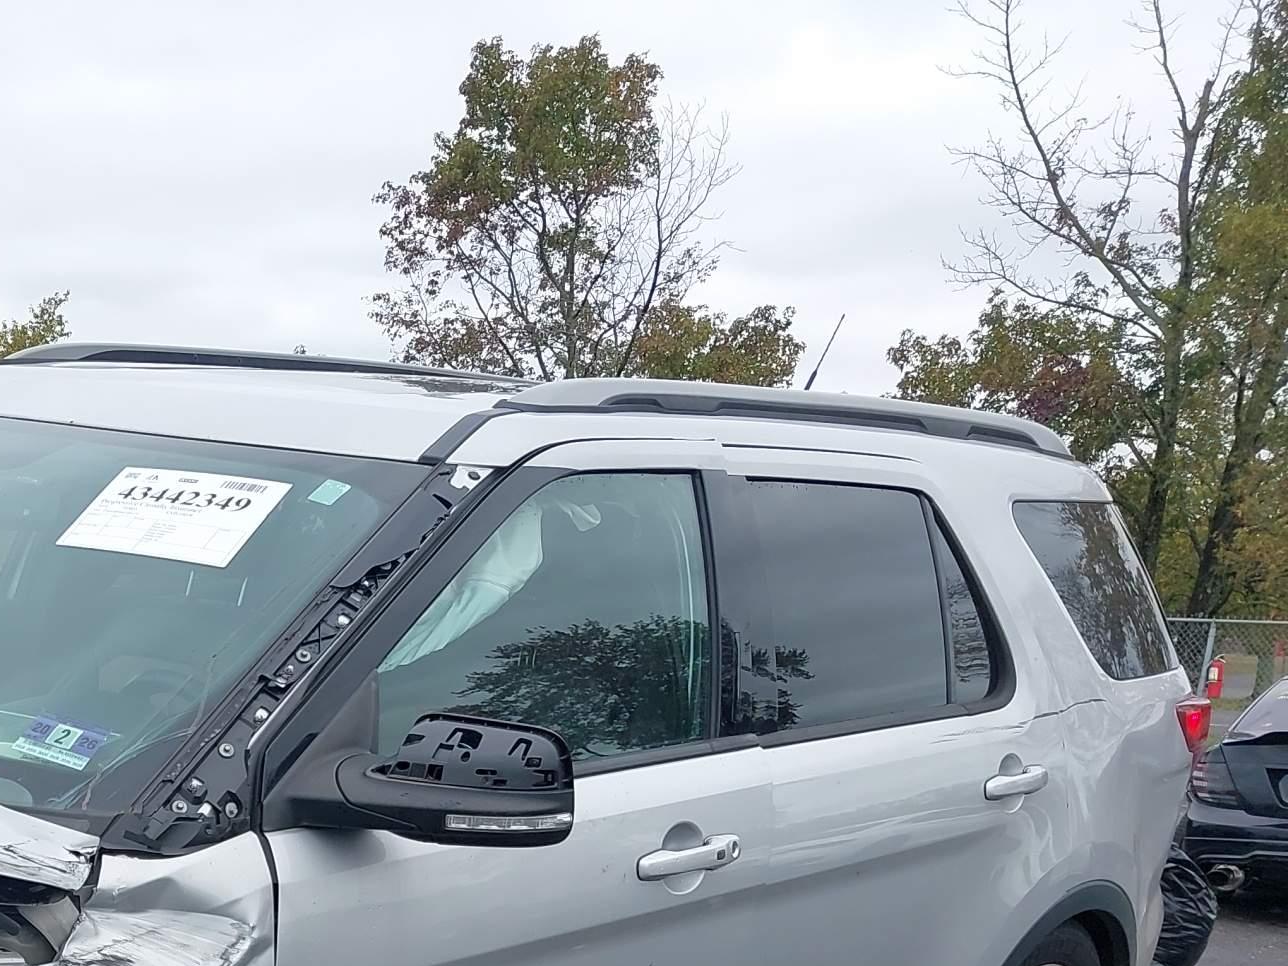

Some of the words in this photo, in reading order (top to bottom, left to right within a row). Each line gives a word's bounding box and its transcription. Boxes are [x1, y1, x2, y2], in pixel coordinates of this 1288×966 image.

[118, 485, 252, 512] 43442349
[32, 722, 51, 735] 20
[54, 728, 71, 744] 2
[78, 737, 98, 750] 26
